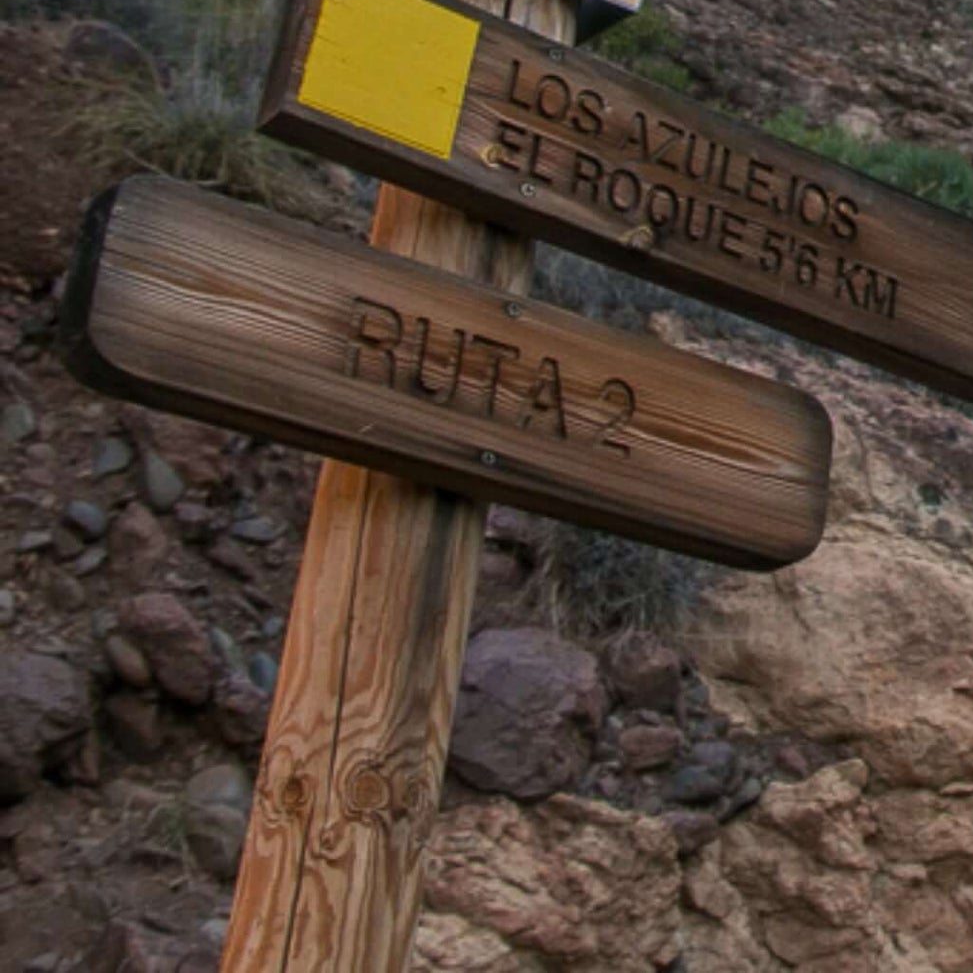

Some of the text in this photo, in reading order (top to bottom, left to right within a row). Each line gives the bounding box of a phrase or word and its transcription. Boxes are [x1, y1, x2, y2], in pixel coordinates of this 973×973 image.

[498, 120, 900, 320] EL ROQUE 5'6 KM
[506, 59, 860, 241] LOS AZULEJOS
[344, 295, 637, 459] RUTA 2
